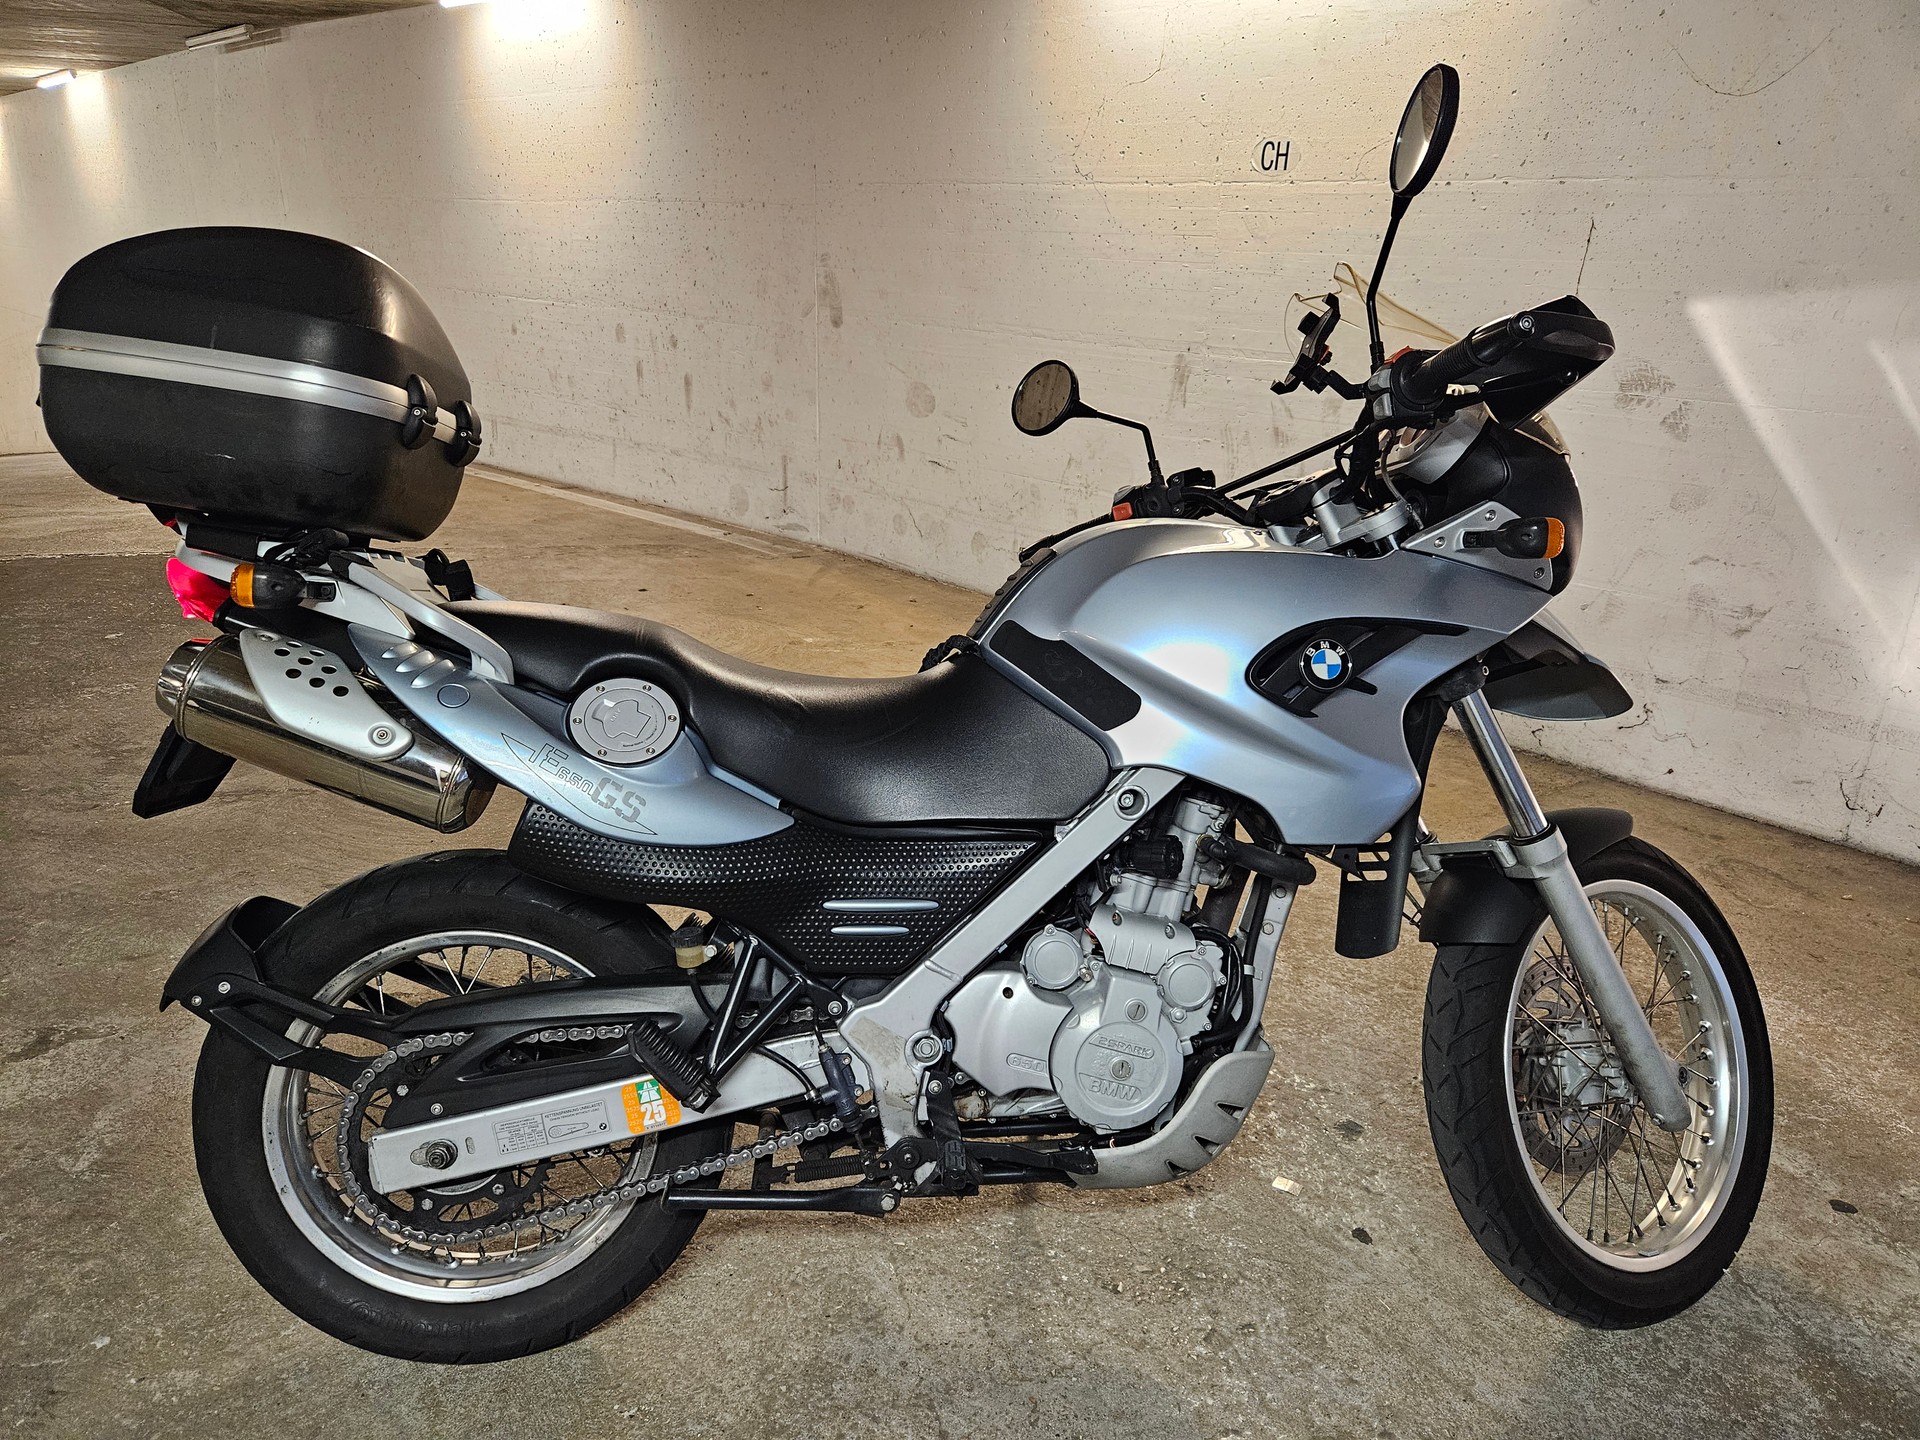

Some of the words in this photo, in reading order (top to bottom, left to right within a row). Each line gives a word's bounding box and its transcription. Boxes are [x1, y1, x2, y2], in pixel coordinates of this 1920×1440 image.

[1261, 141, 1290, 170] CH
[1306, 641, 1345, 657] BMW
[1011, 1056, 1044, 1072] 650
[1088, 1079, 1137, 1101] BMW
[640, 1099, 667, 1126] 25
